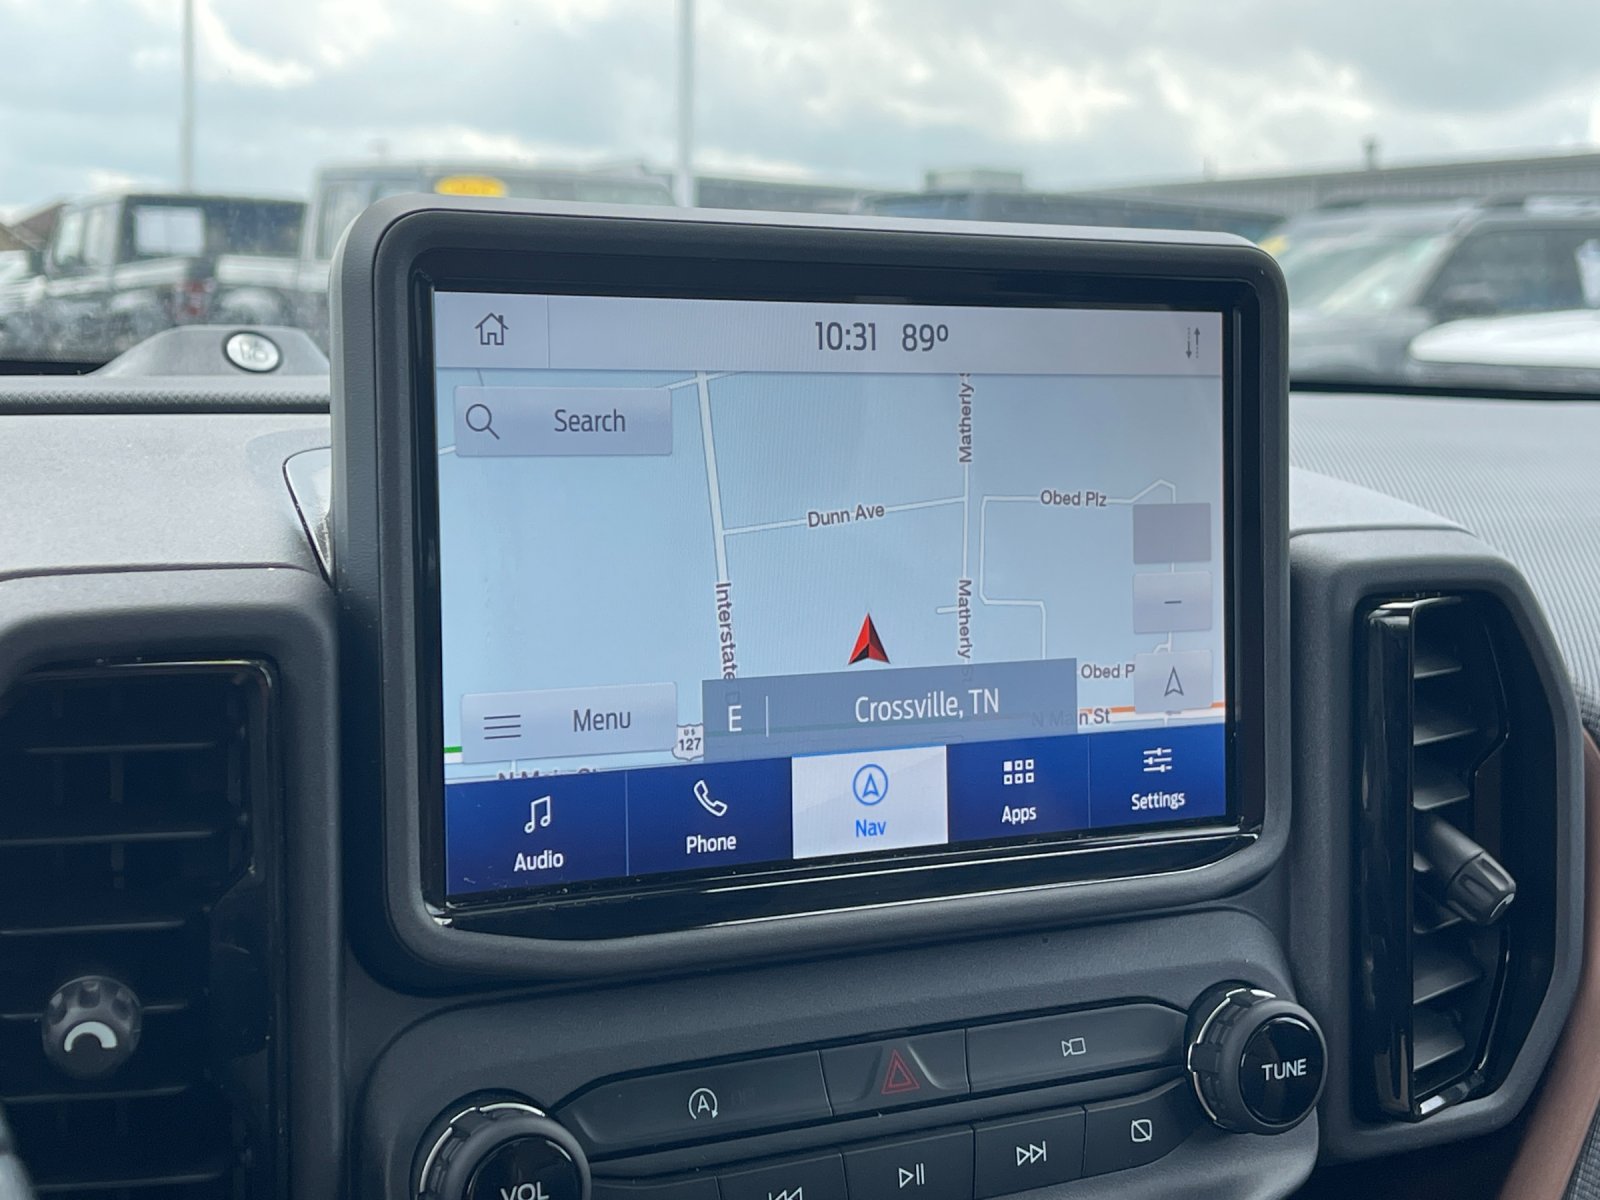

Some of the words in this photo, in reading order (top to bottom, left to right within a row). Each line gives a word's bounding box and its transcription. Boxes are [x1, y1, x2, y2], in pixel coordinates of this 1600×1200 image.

[815, 321, 876, 351] 10:31
[554, 409, 626, 433] Search
[959, 382, 975, 463] Matherly
[1041, 489, 1081, 506] Obed
[1085, 491, 1107, 507] Plz
[808, 511, 850, 528] Dunn
[855, 504, 885, 521] Ave
[958, 580, 973, 659] Matherly
[716, 582, 738, 681] Interstate
[1081, 664, 1120, 679] Obed
[855, 691, 963, 723] Crossville,
[968, 688, 999, 715] TN
[1094, 707, 1110, 724] St
[573, 709, 631, 732] Menu
[728, 705, 742, 732] E
[679, 737, 701, 751] 127
[1131, 791, 1185, 811] Settings
[1001, 805, 1037, 825] Apps
[855, 820, 886, 838] Nav
[686, 835, 737, 855] Phone
[513, 850, 564, 872] Audio
[1261, 1058, 1307, 1081] TUNE
[500, 1181, 550, 1200] VOL
